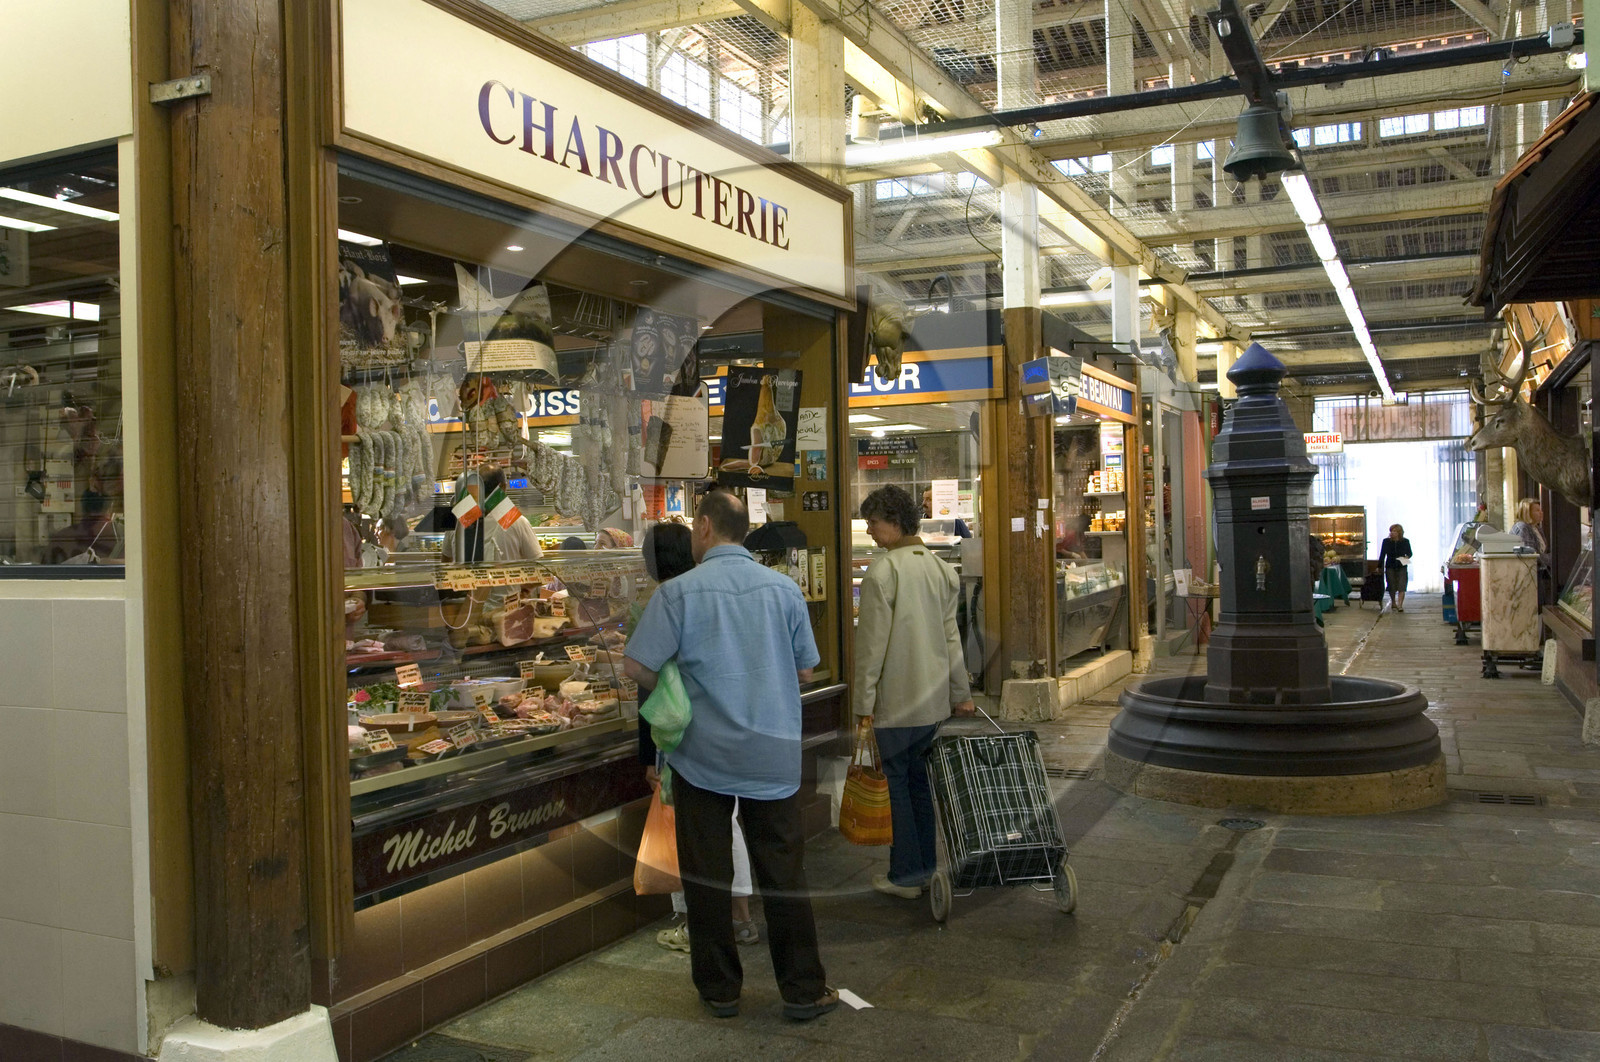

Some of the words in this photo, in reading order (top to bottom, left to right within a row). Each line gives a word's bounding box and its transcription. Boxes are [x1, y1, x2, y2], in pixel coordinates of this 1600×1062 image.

[478, 79, 790, 251] CHARCUTERIE
[1088, 377, 1123, 411] BEAUVAU
[1304, 434, 1341, 444] UCHERIE
[383, 814, 477, 874] Michel
[488, 797, 566, 839] Brunon
